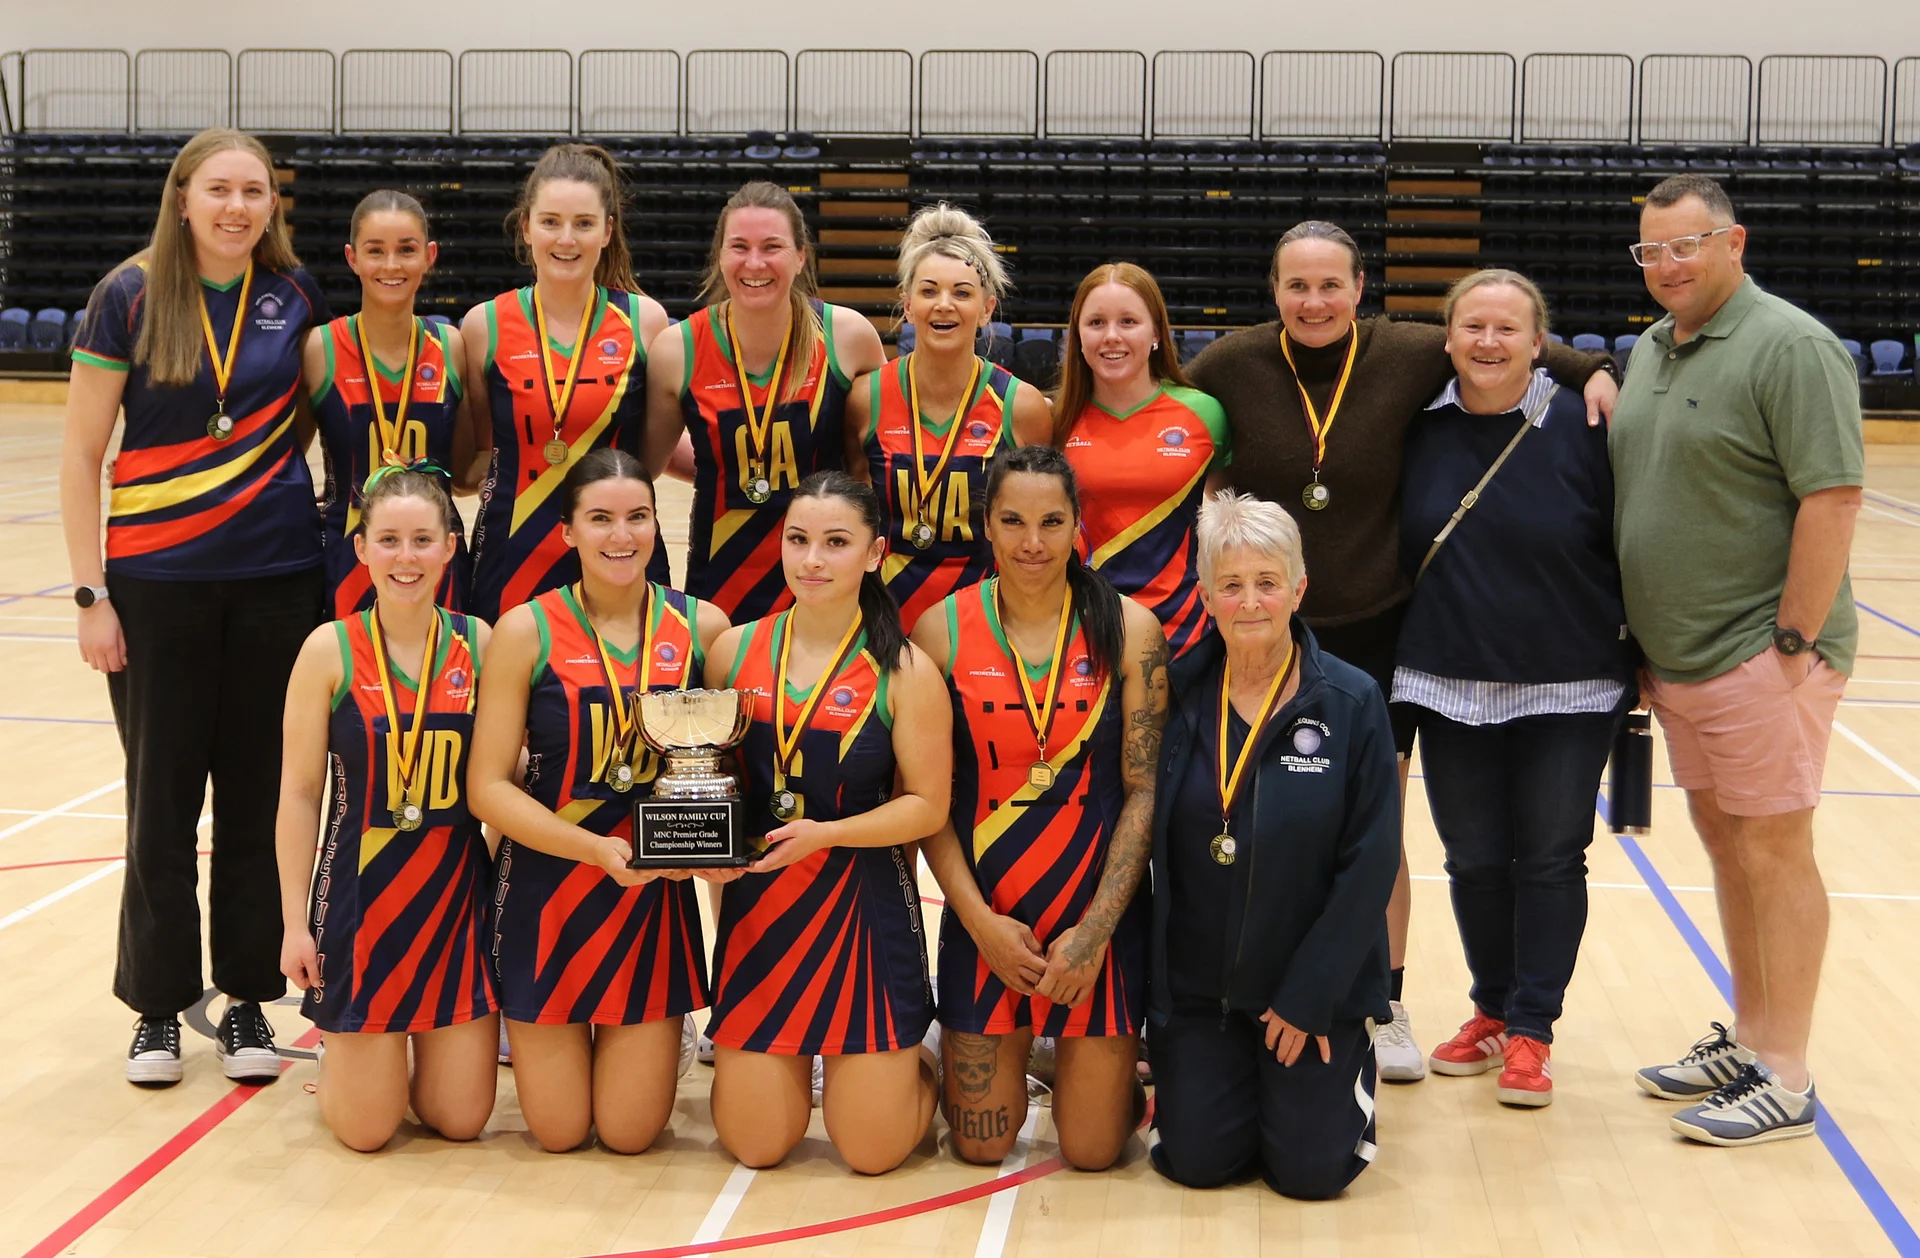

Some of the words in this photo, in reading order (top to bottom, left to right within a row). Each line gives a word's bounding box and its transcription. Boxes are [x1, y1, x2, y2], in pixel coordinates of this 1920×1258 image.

[735, 420, 799, 495] GA
[897, 468, 974, 542] WA
[386, 730, 462, 812] WD
[650, 841, 696, 850] Championship
[699, 830, 718, 838] Grade
[951, 1104, 1008, 1142] 0606
